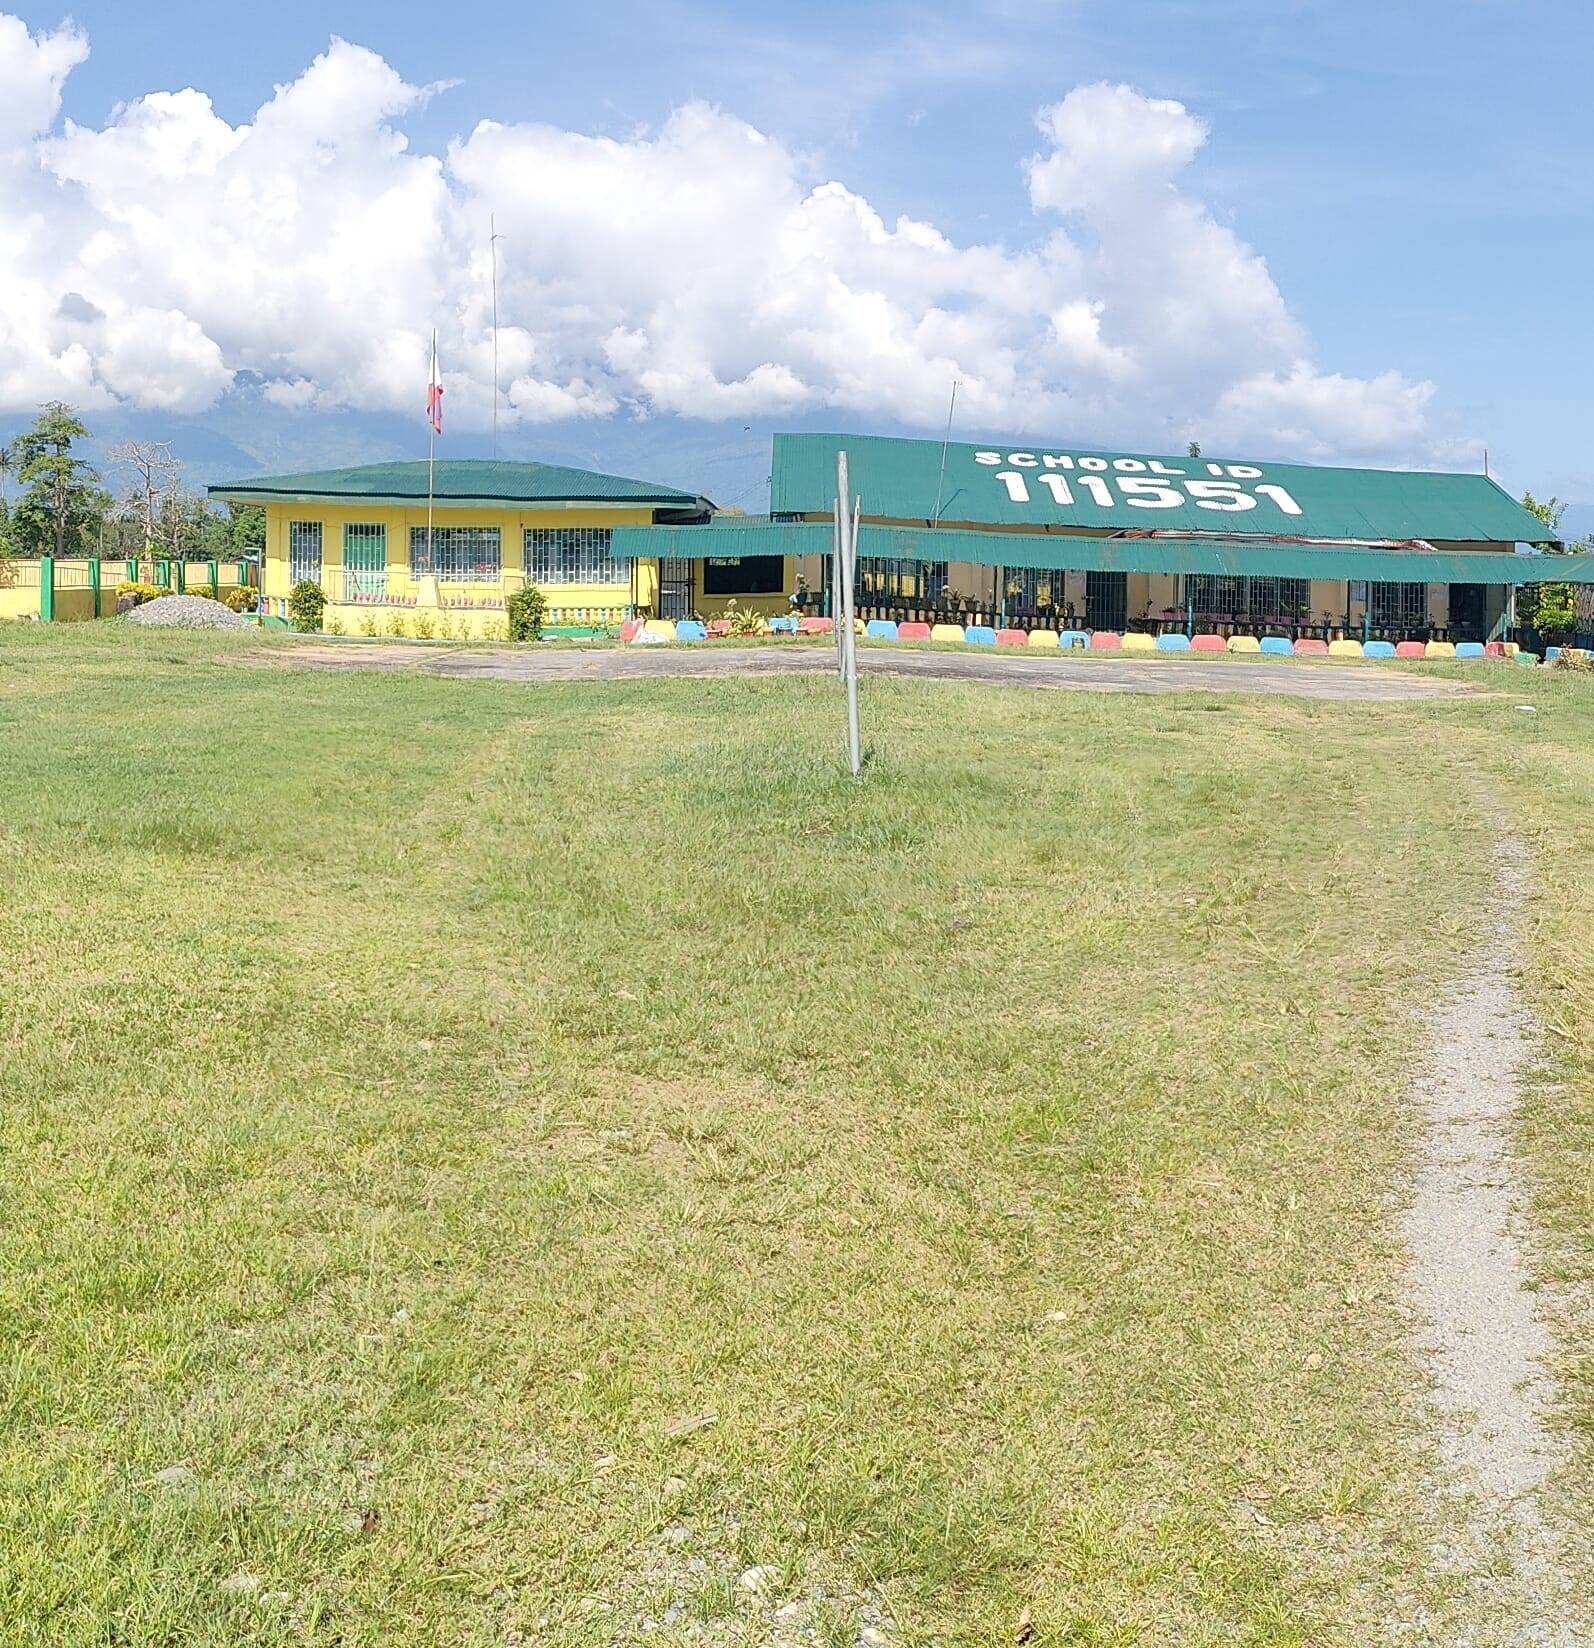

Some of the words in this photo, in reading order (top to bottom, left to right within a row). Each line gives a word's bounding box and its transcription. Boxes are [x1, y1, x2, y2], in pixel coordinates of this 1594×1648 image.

[975, 451, 1186, 475] SCHOOL
[1206, 463, 1263, 478] ID
[996, 471, 1303, 515] 111551
